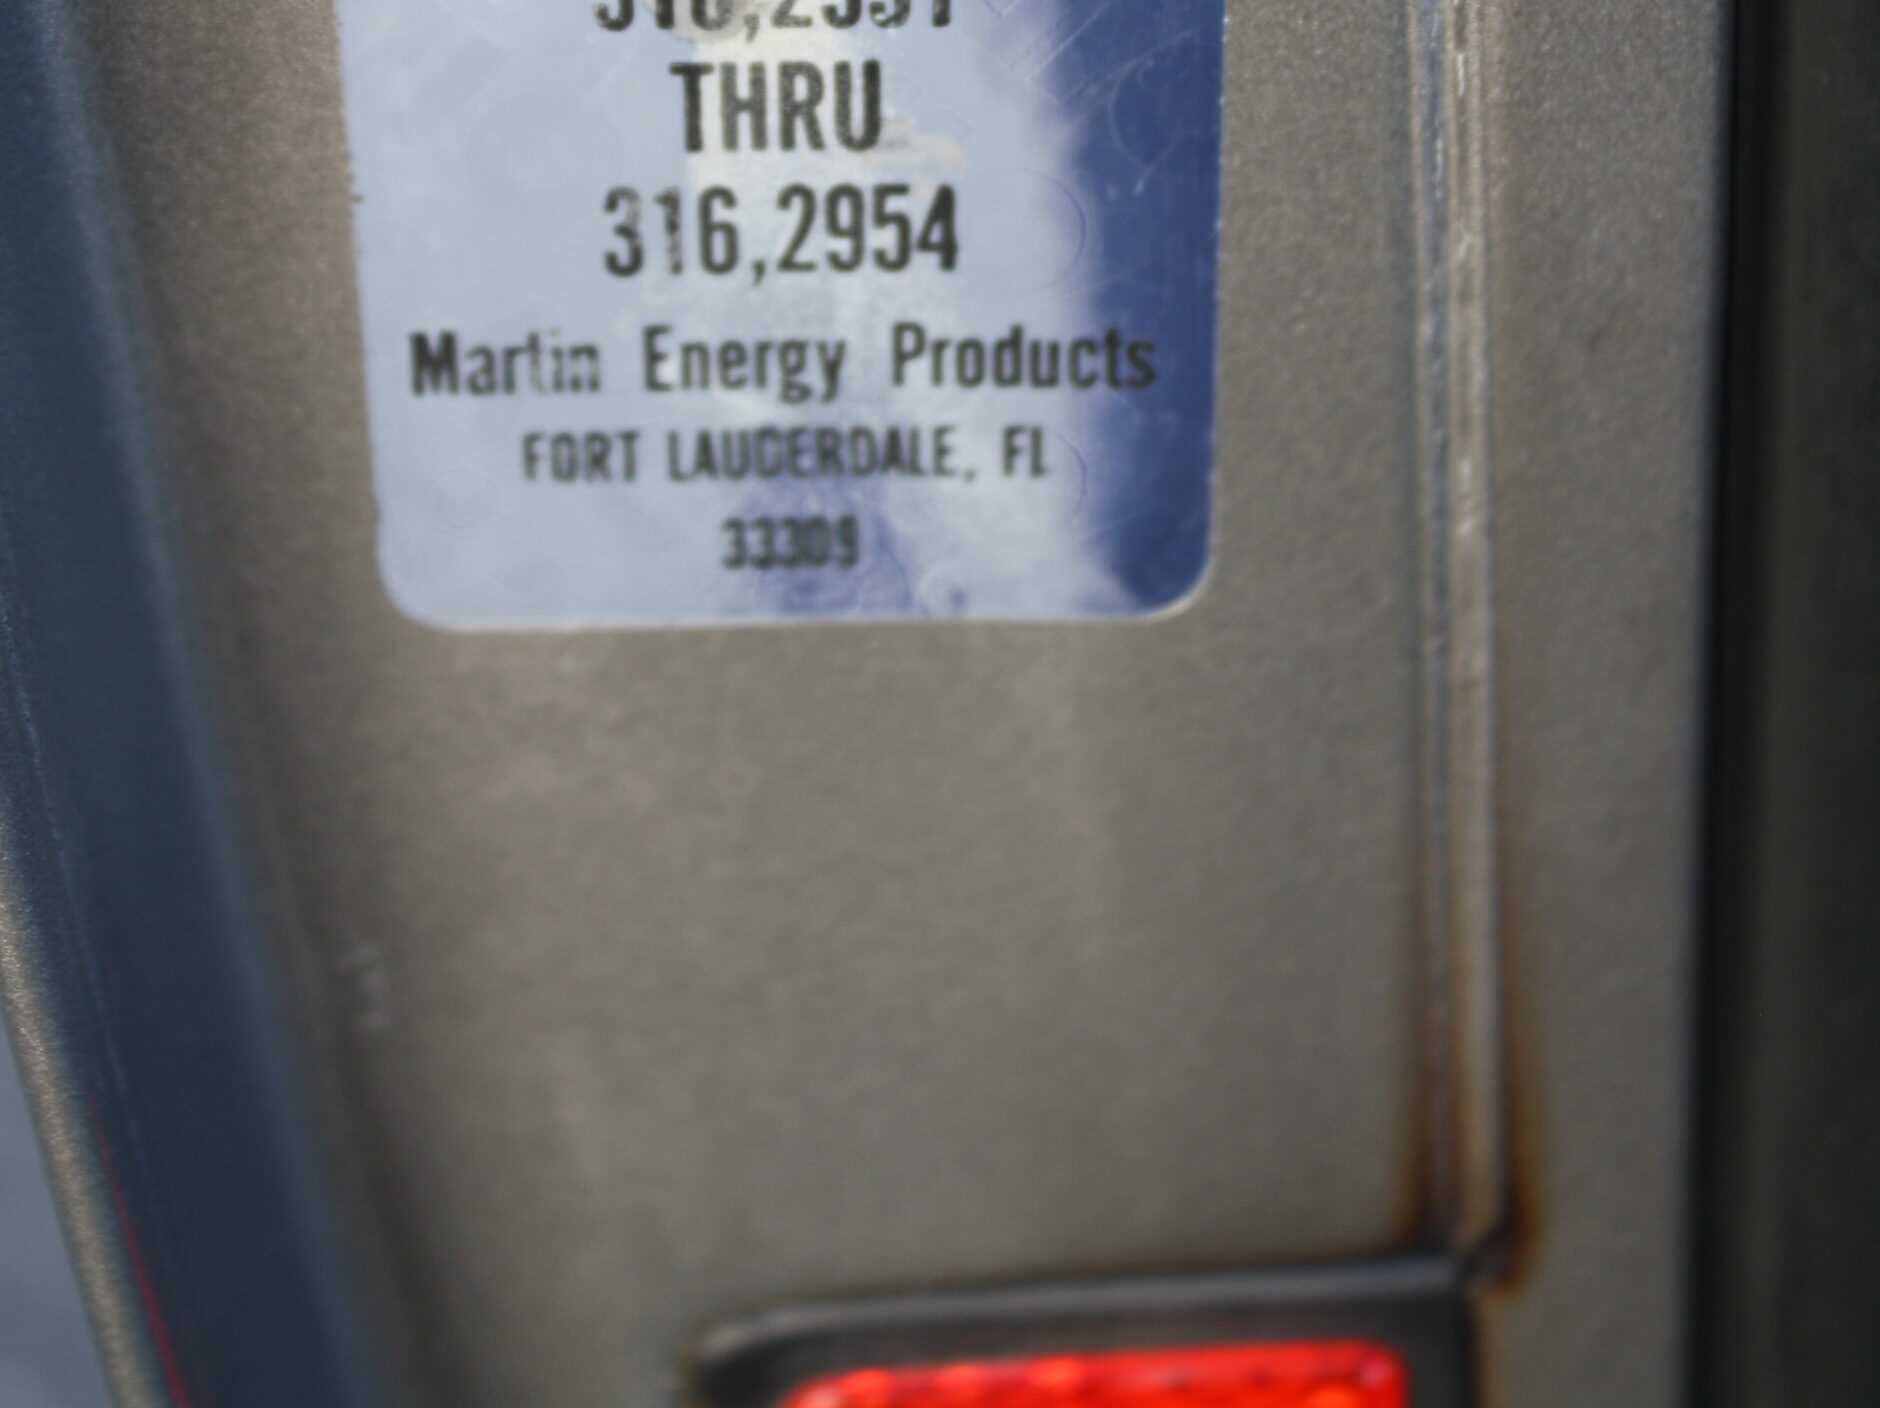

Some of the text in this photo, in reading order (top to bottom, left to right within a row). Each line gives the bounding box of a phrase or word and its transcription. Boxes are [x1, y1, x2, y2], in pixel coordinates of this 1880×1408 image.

[669, 58, 882, 154] THRU
[602, 183, 960, 285] 316,2954
[408, 321, 1159, 405] Martin Energy Products
[522, 428, 641, 483] FORT
[1001, 423, 1051, 479] FL
